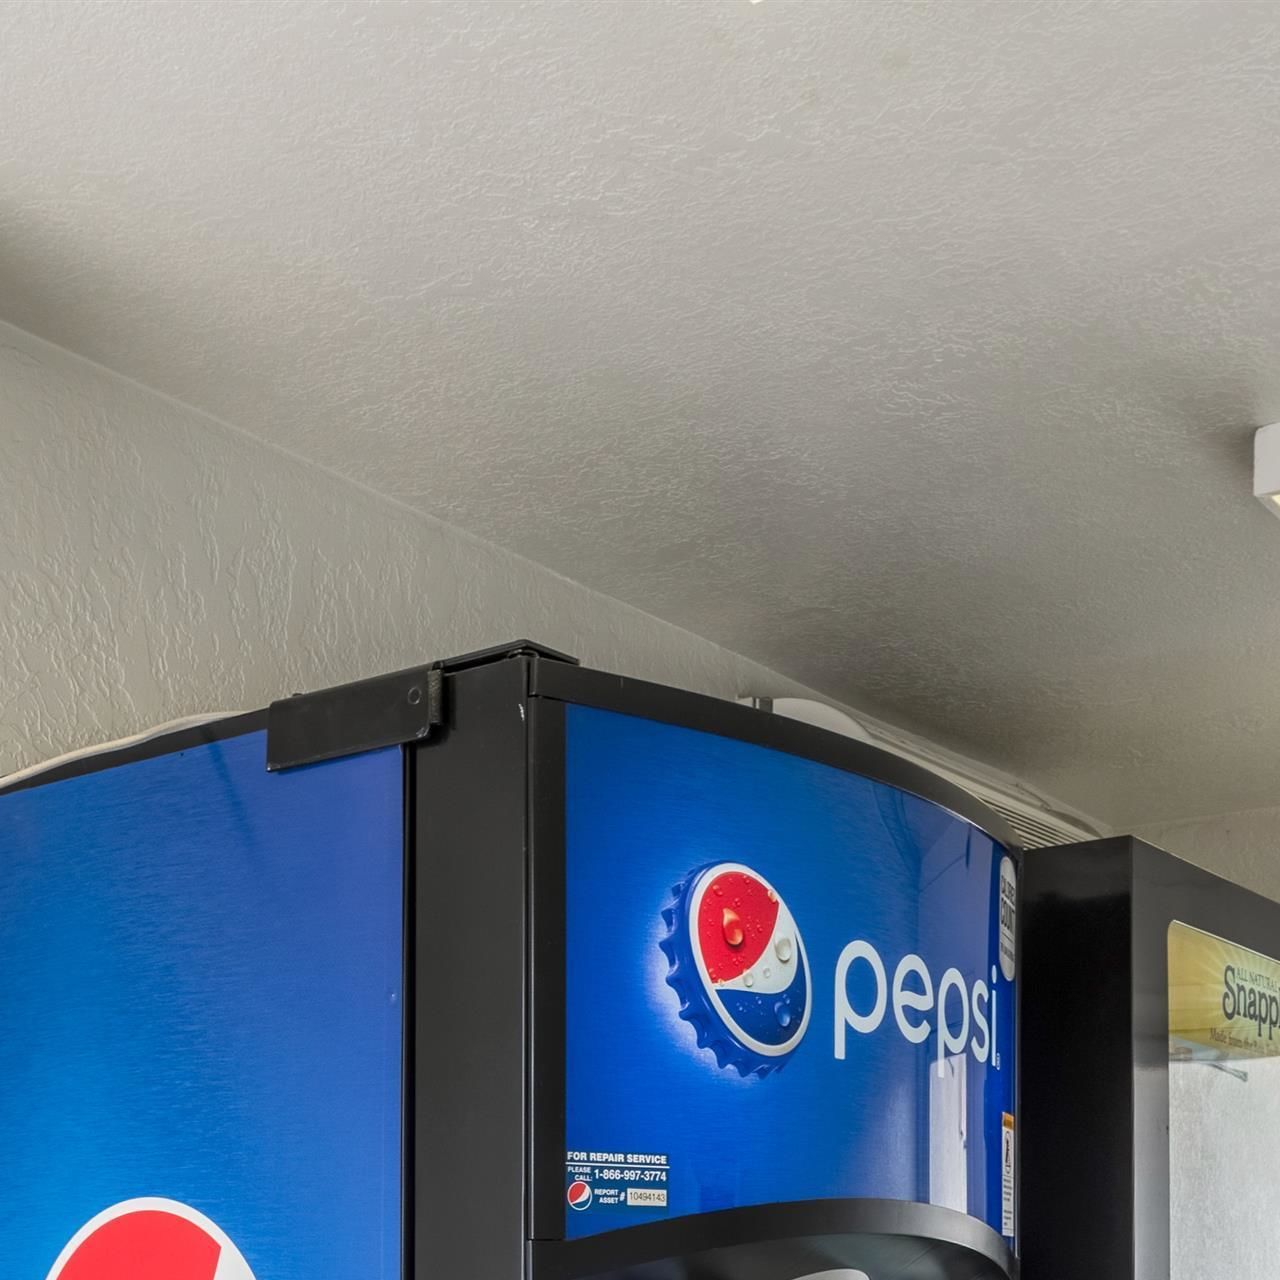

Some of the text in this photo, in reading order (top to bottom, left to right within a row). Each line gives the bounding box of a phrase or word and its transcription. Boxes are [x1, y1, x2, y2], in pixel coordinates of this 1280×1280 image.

[1236, 967, 1278, 993] ALL NATURAL
[833, 939, 998, 1078] pepsi
[566, 1151, 667, 1165] FOR REPAIR SERVICE
[594, 1168, 667, 1182] 1-866-997-3774
[594, 1188, 619, 1196] REPORT
[619, 1191, 666, 1203] # 10494143
